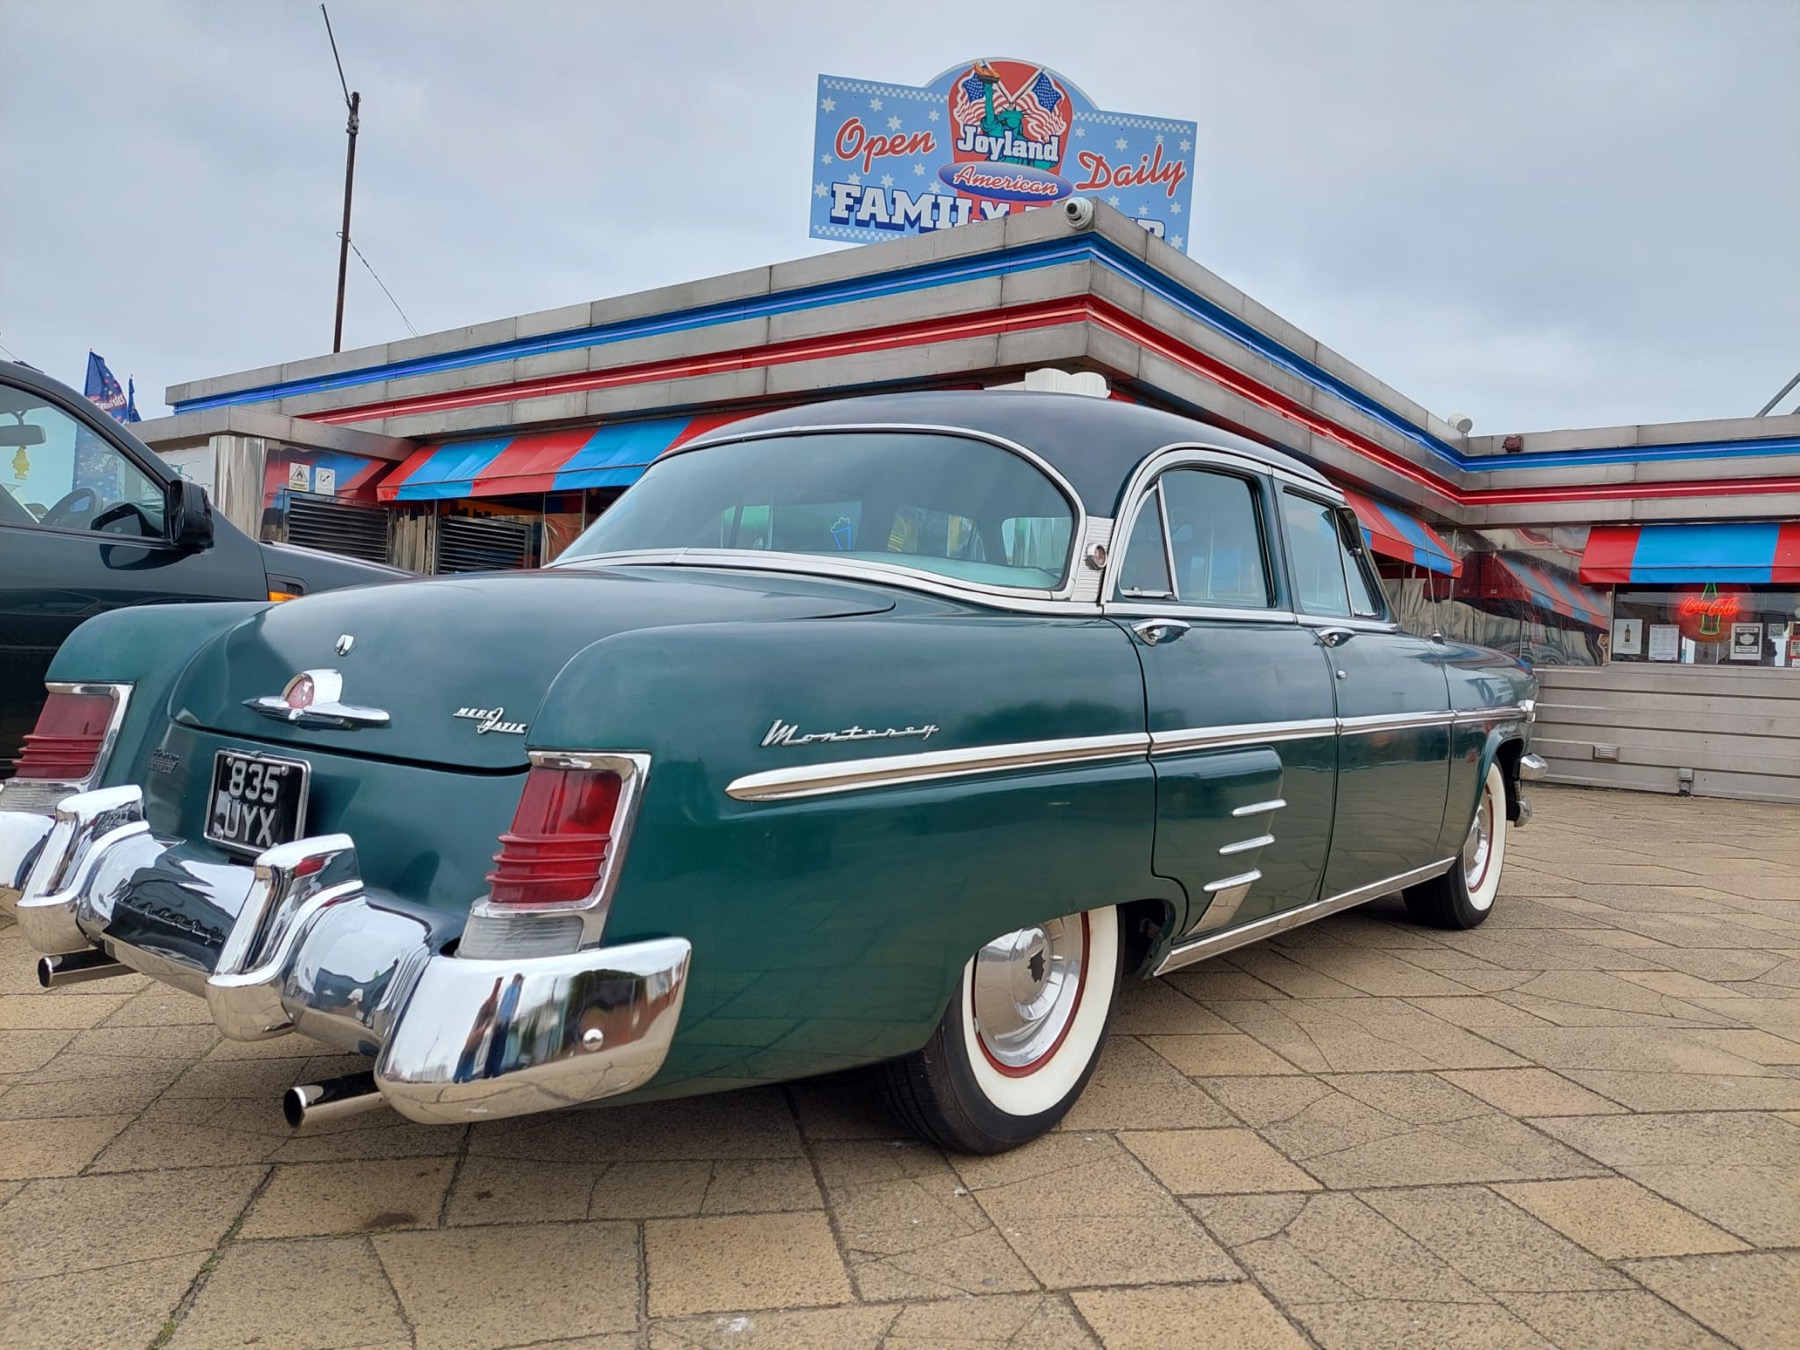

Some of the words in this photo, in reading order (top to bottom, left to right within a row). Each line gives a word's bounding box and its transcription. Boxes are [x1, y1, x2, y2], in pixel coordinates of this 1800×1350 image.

[835, 117, 937, 173] Open
[957, 124, 1060, 161] Joyland
[953, 165, 1059, 196] American
[1075, 142, 1186, 197] Daily
[761, 719, 939, 746] Monterey
[229, 760, 281, 803] 835
[224, 799, 276, 847] UYX
